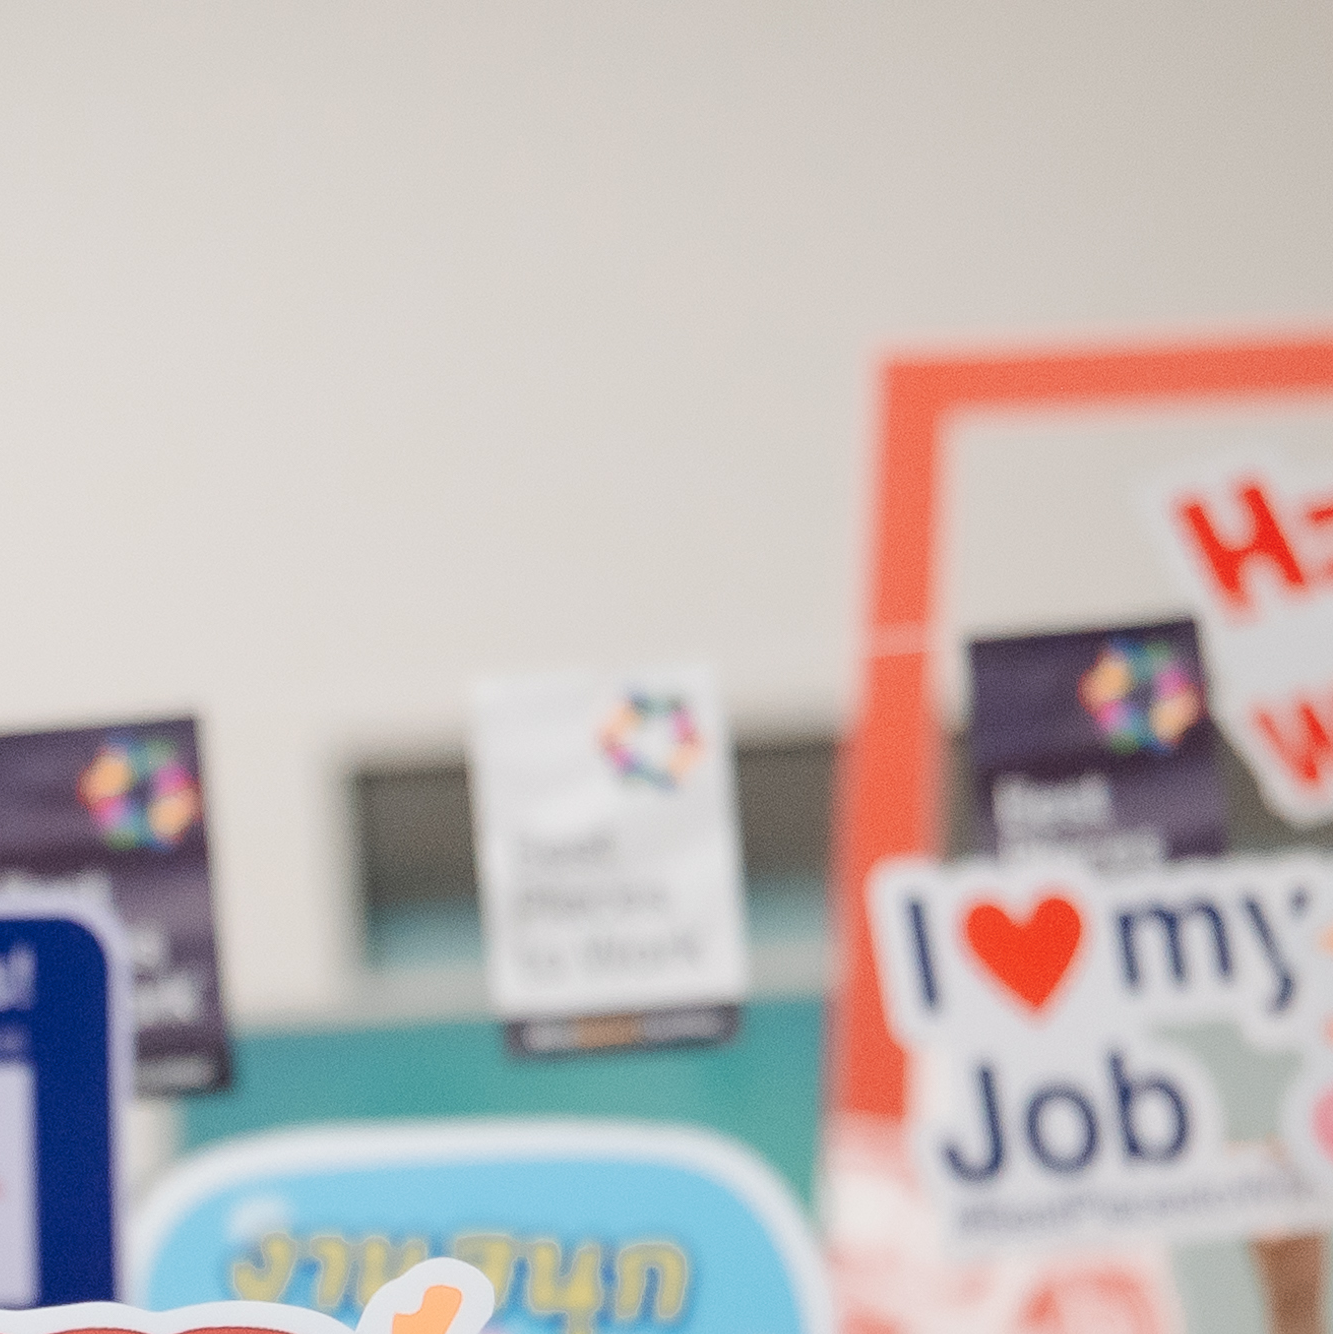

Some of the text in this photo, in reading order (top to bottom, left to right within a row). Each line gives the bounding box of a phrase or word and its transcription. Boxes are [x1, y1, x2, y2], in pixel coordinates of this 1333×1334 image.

[903, 886, 1310, 1016] I my
[939, 1048, 1191, 1183] Job
